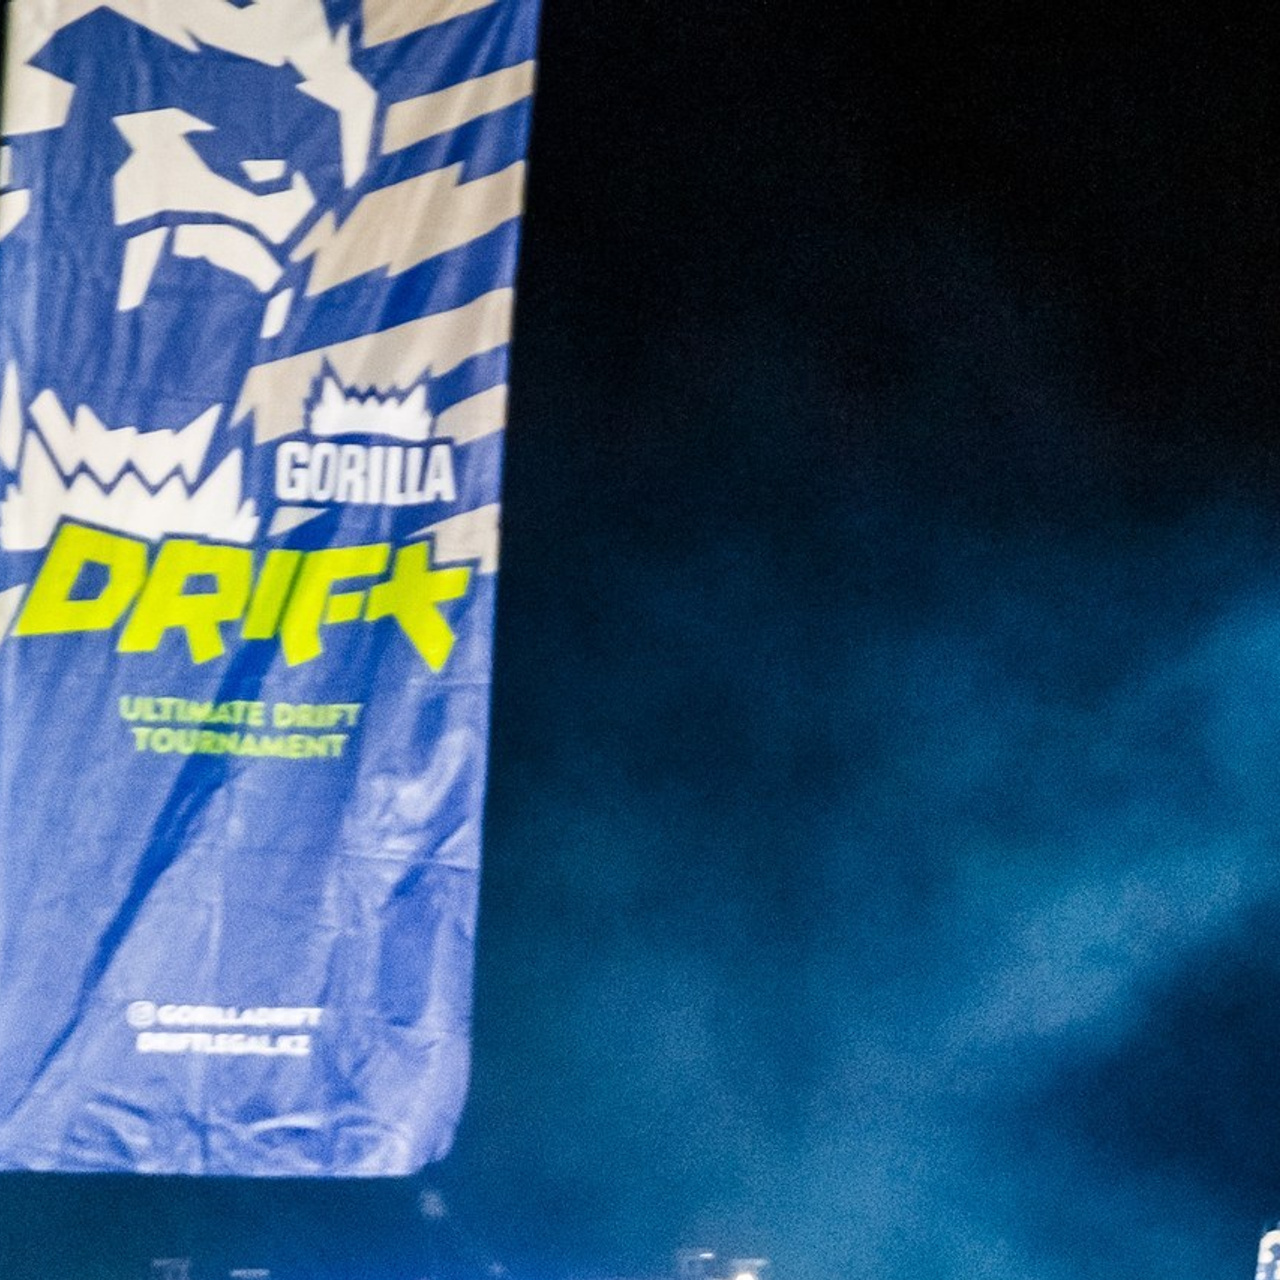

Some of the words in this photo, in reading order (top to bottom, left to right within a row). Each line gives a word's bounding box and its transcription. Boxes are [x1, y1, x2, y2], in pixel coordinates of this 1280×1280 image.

[276, 441, 457, 505] GORILLA
[14, 522, 472, 673] DRIFT
[119, 696, 265, 727] ULTIMATE
[273, 702, 362, 729] DRIFT
[132, 727, 348, 758] TOURNAMENT
